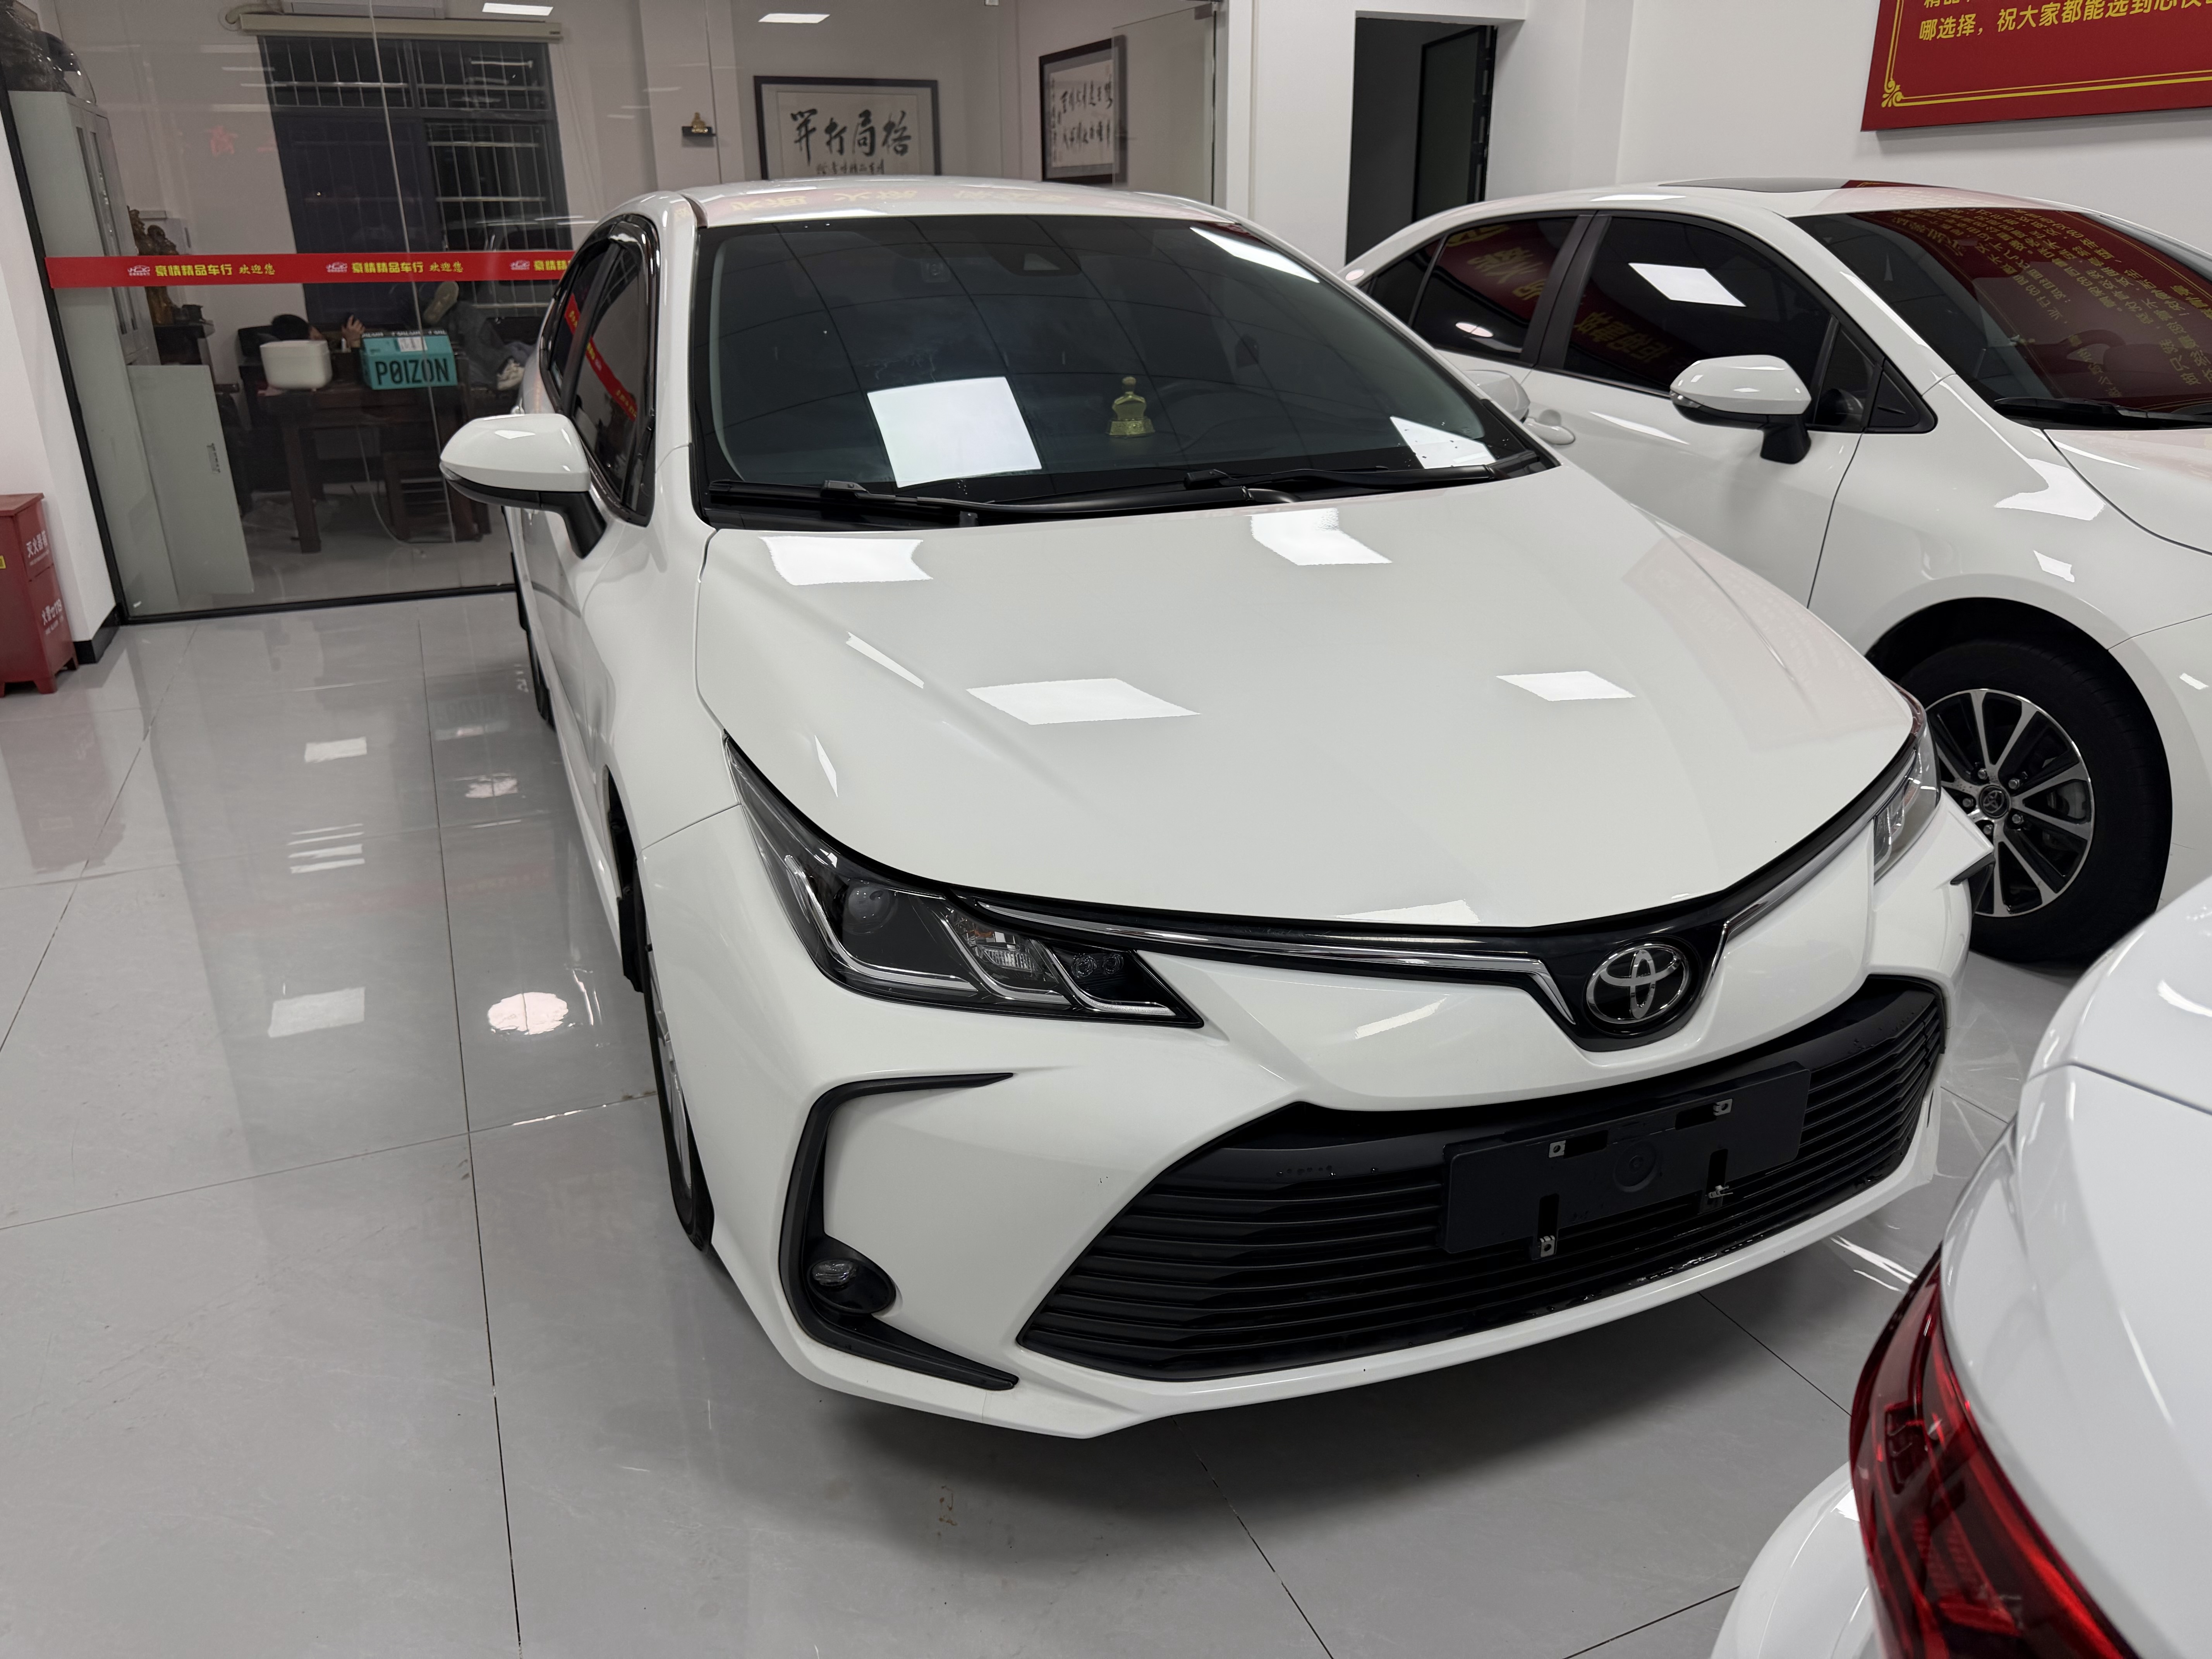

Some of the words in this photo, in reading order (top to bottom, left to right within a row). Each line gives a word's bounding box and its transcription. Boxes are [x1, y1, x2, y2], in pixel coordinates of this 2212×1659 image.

[155, 263, 232, 276] 豪情精品车行
[239, 263, 275, 275] 欢迎您
[351, 262, 424, 273] 豪情精品车行
[429, 261, 463, 273] 欢迎您
[375, 358, 450, 385] POIZON
